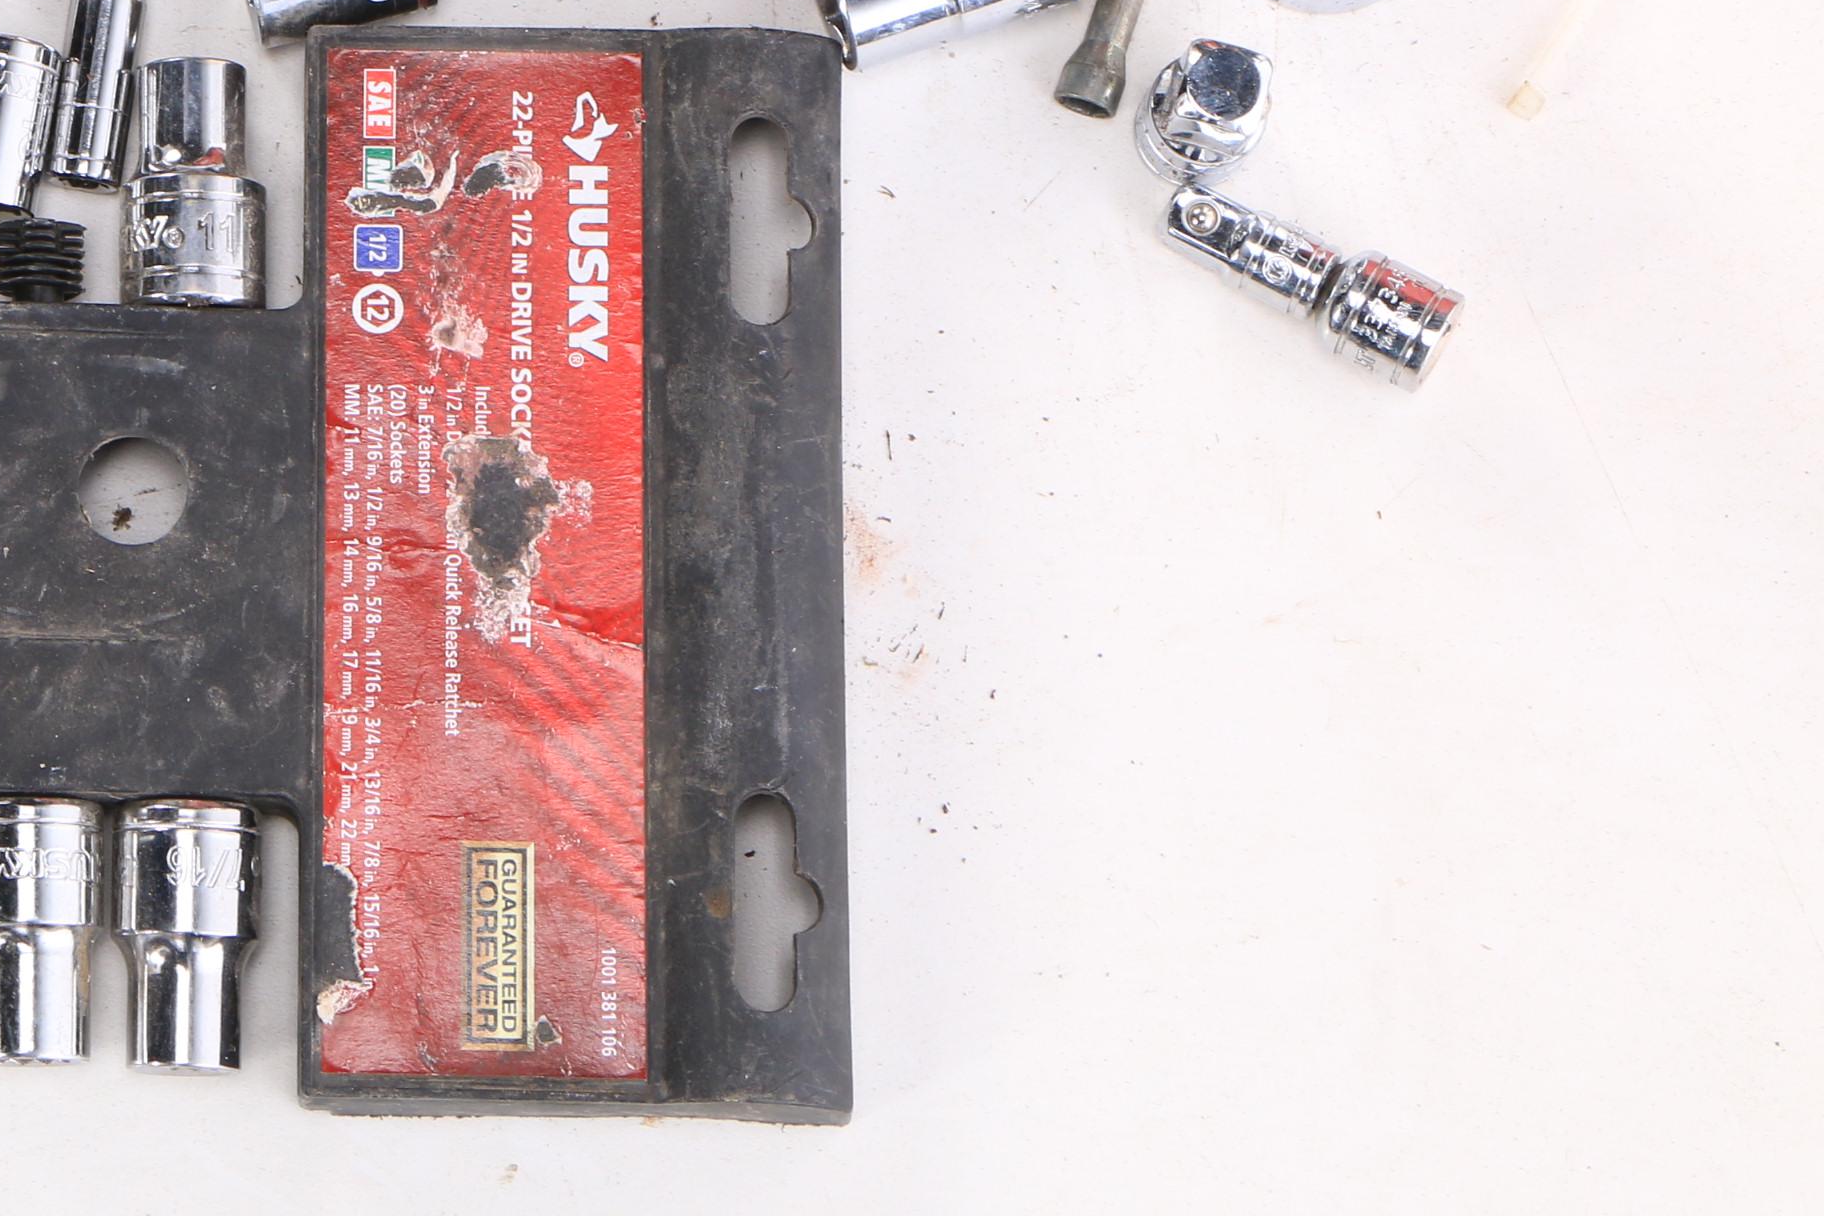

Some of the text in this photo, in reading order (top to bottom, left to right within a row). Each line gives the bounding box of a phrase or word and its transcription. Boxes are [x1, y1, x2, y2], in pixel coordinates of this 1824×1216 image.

[367, 80, 393, 127] SAE
[197, 211, 236, 254] 11
[512, 209, 533, 247] 1/2
[368, 233, 388, 263] 1/2
[365, 294, 390, 322] 12
[510, 281, 533, 361] DRIVE
[344, 383, 360, 421] MM:
[366, 383, 384, 422] SAE:
[445, 386, 462, 411] 1/2
[387, 384, 408, 485] (20) Sockets
[446, 414, 461, 426] in
[344, 427, 361, 445] 11
[366, 426, 384, 461] 7/16
[417, 384, 435, 496] 3 in Extension
[341, 447, 357, 477] mm,
[364, 463, 380, 481] in,
[343, 483, 360, 501] 13
[366, 486, 384, 512] 1/2
[341, 503, 357, 532] mm,
[364, 514, 380, 532] in,
[343, 538, 359, 557] 14
[366, 535, 383, 573] 9/16
[340, 559, 356, 588] mm,
[363, 574, 379, 592] in,
[444, 554, 462, 601] Quick
[342, 594, 359, 613] 16
[365, 596, 383, 625] 5/8
[340, 615, 356, 644] mm,
[363, 626, 379, 644] in,
[444, 605, 462, 670] Release
[342, 650, 359, 669] 17
[364, 649, 382, 693] 11/16
[339, 671, 355, 700] mm,
[341, 706, 358, 725] 19
[362, 695, 378, 712] in,
[444, 672, 461, 737] Ratchet
[339, 727, 354, 757] mm,
[363, 716, 381, 745] 3/4
[362, 747, 378, 765] in,
[341, 762, 358, 781] 21
[339, 784, 354, 814] mm,
[363, 770, 381, 816] 13/16
[340, 818, 358, 839] 22
[362, 818, 378, 835] in,
[165, 845, 247, 892] 7/16
[363, 840, 381, 869] 7/8
[362, 870, 378, 888] in,
[363, 893, 381, 939] 15/16
[476, 858, 499, 1032] FOREVER
[501, 858, 518, 1033] GUARANTEED
[363, 965, 381, 973] 1
[601, 946, 618, 1057] 1001 381 106
